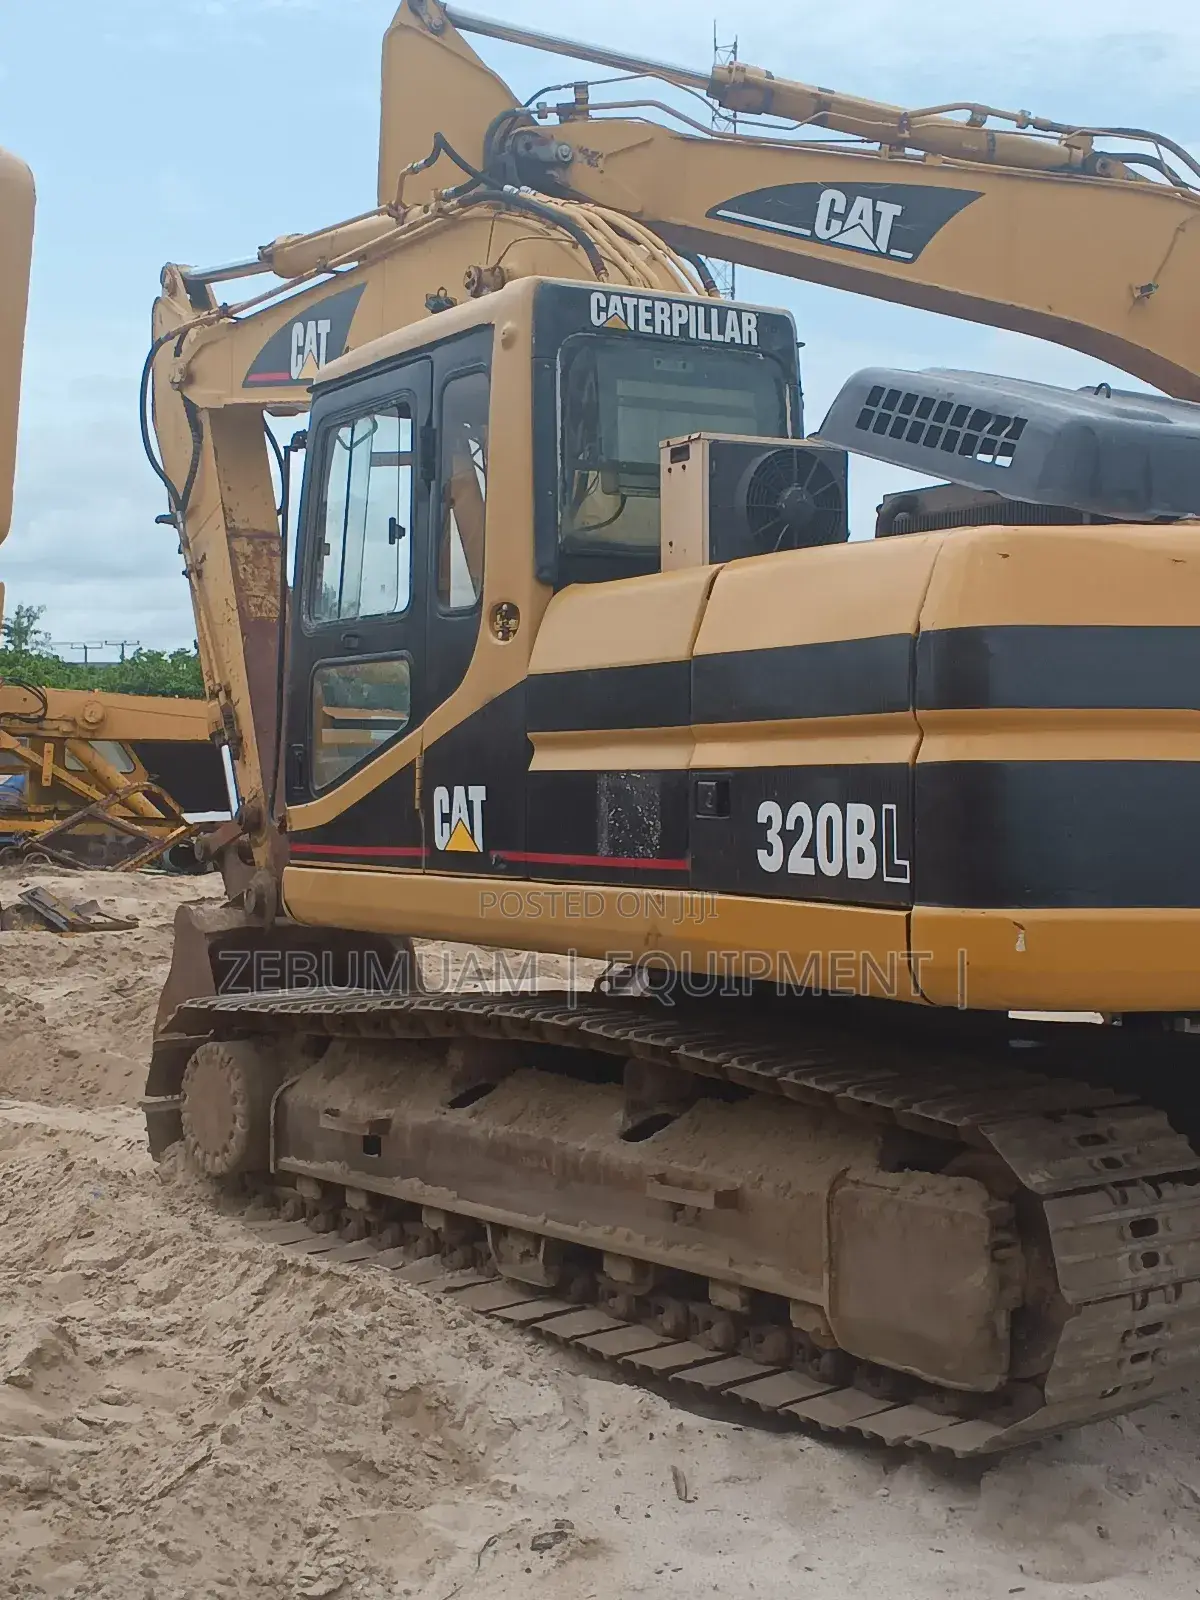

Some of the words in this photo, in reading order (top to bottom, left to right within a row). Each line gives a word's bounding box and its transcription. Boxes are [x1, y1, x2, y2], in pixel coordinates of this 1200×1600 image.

[814, 188, 903, 253] CAT
[290, 319, 331, 380] CAT
[590, 291, 758, 346] CATERPILLAR
[433, 785, 487, 852] CAT
[757, 800, 910, 883] 320BL
